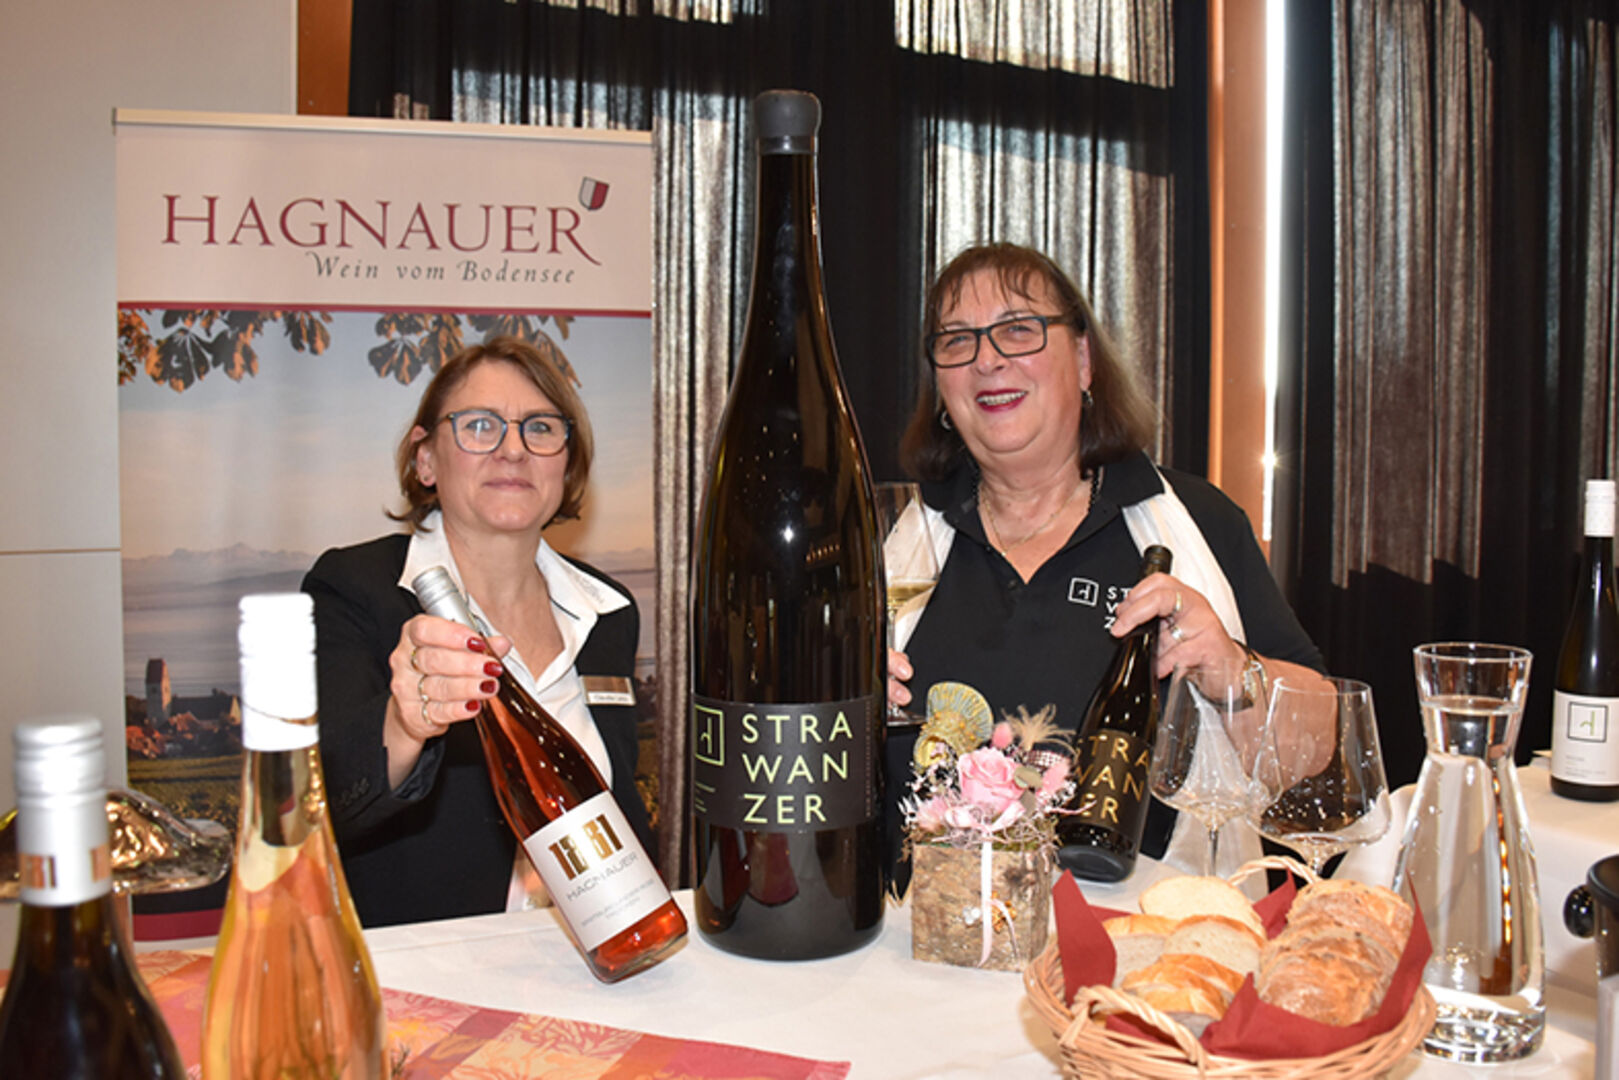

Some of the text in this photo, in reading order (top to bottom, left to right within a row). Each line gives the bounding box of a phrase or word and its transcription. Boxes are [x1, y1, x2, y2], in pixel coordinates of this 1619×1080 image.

[161, 194, 602, 266] HAGNAUER
[306, 251, 577, 284] Wein vom Bodensee
[742, 711, 853, 744] STRA
[742, 751, 848, 784] WAN
[743, 793, 827, 824] ZER
